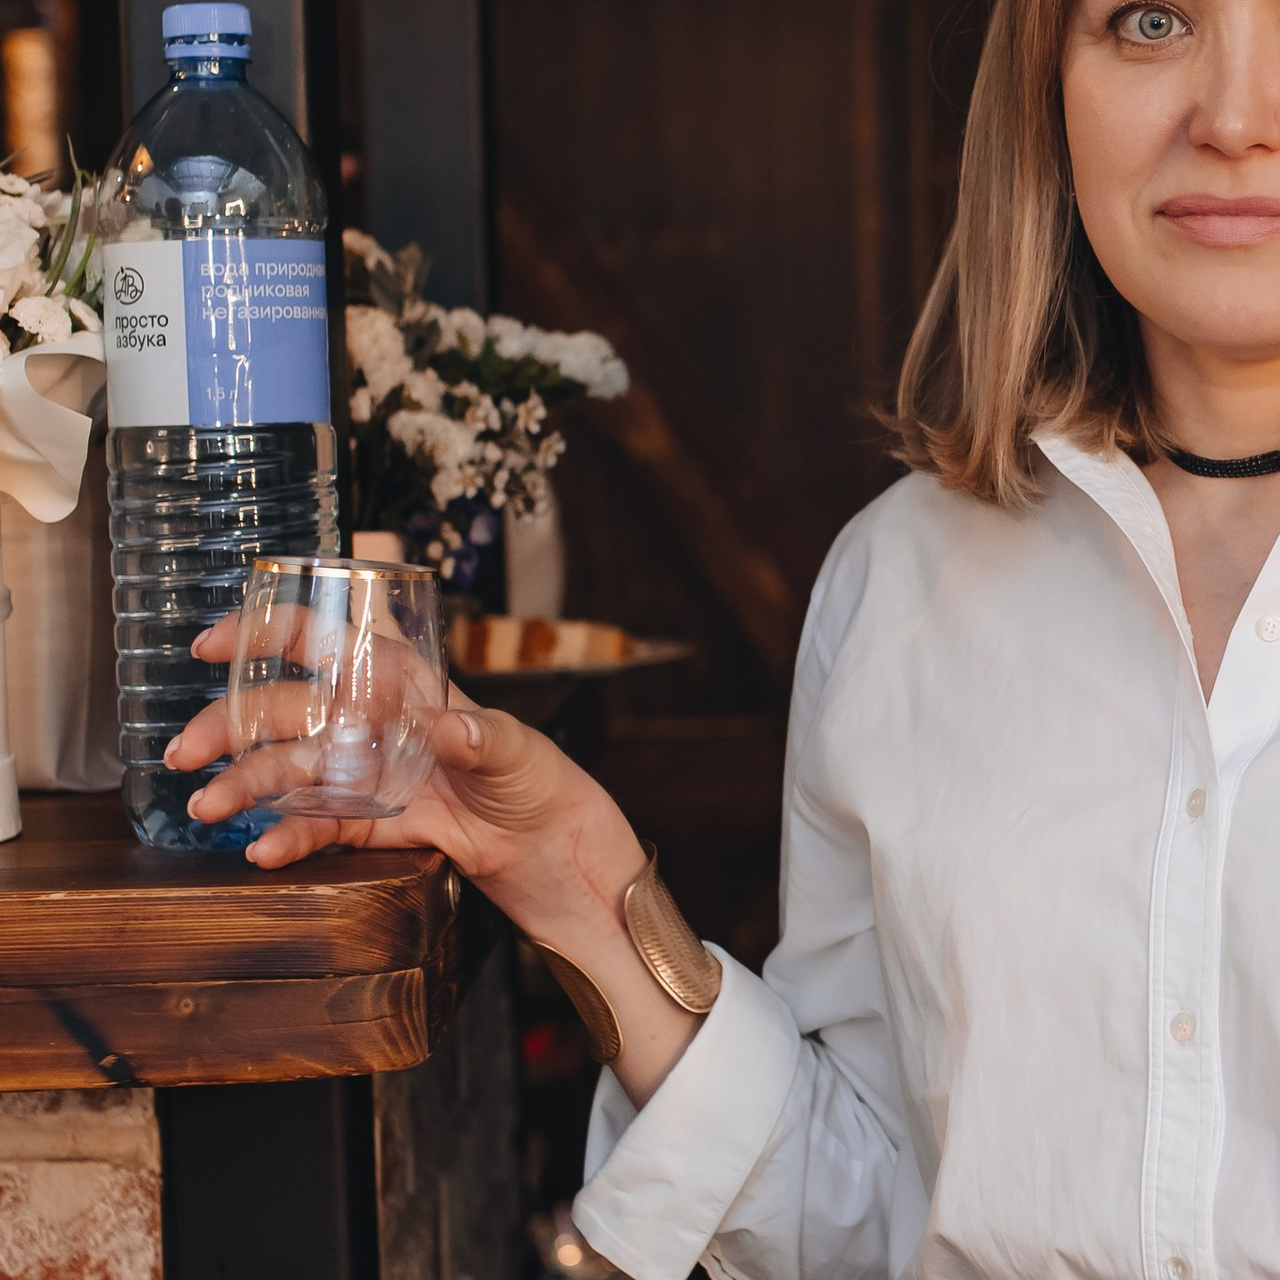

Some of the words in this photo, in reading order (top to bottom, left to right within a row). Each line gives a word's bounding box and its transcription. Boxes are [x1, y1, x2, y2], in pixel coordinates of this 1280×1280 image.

[200, 262, 249, 277] вода
[201, 284, 310, 302] родниковая
[115, 314, 169, 334] просто
[116, 329, 167, 352] азбука
